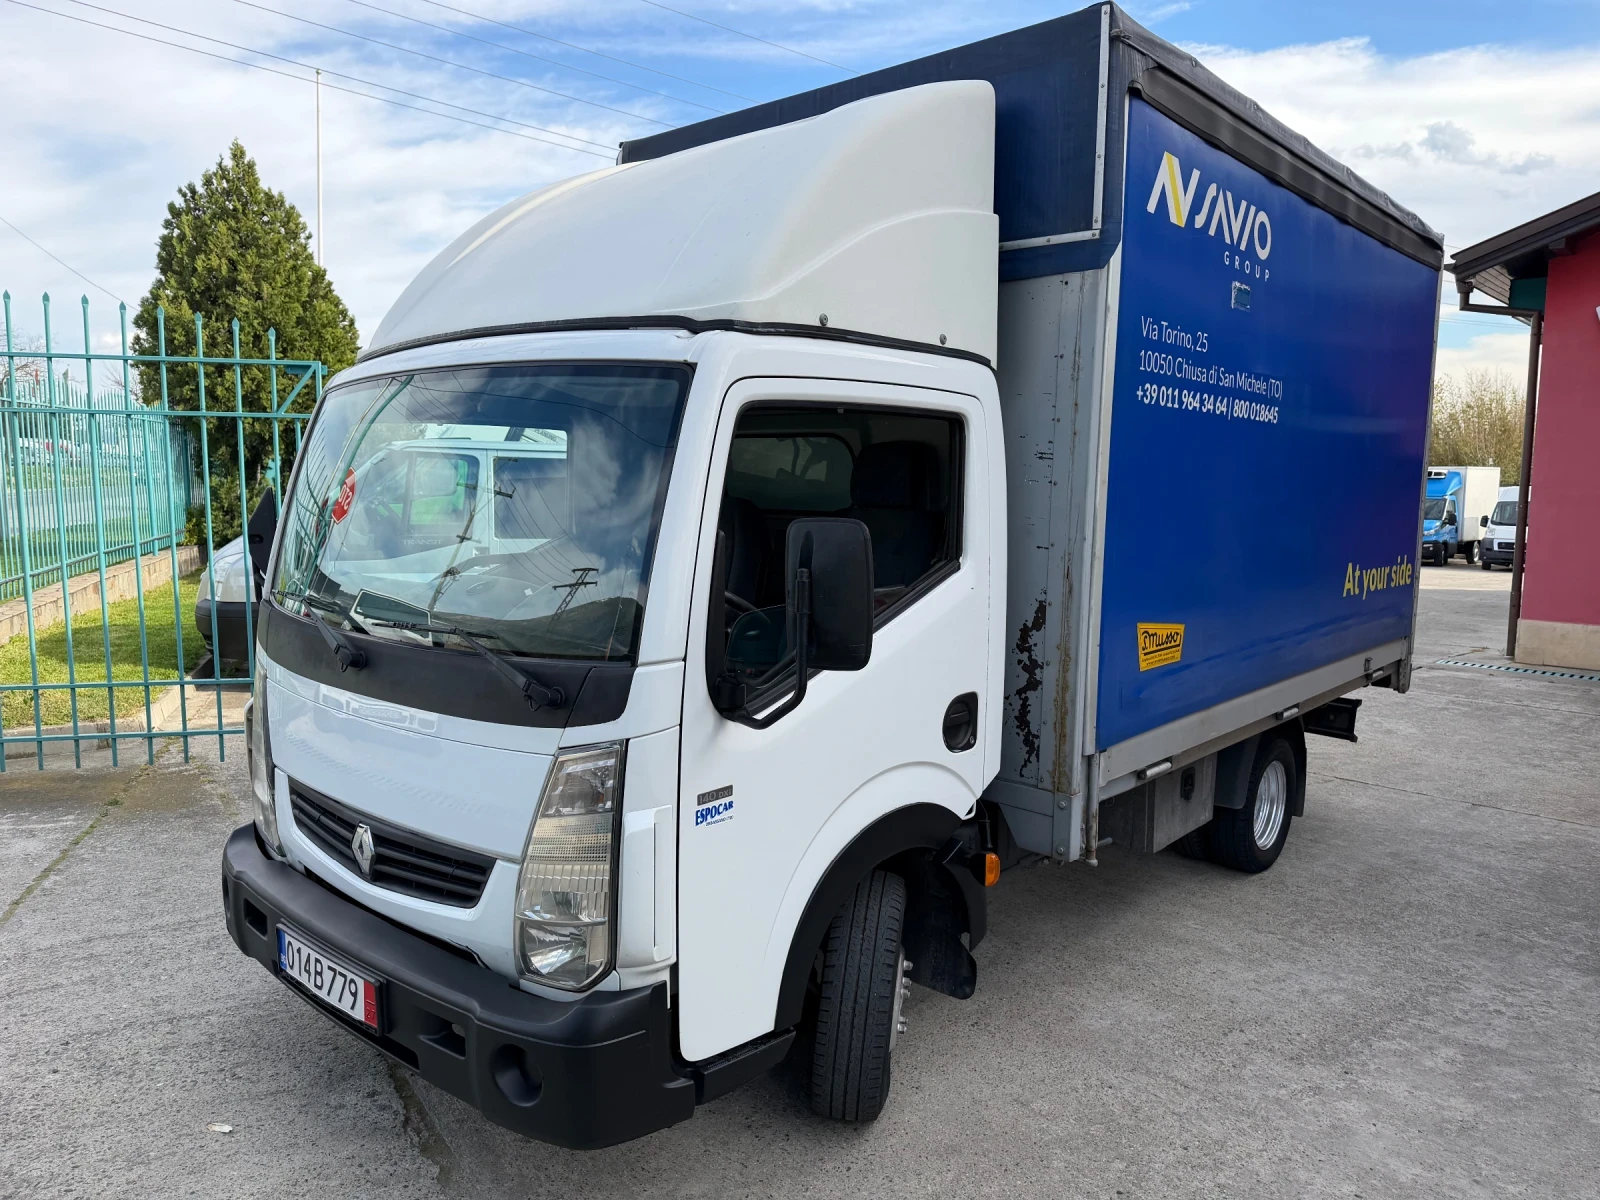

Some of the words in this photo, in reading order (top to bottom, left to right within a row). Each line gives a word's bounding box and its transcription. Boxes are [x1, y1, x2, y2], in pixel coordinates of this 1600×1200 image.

[1194, 182, 1272, 260] SAVIO
[1224, 250, 1270, 282] GROUP
[1141, 315, 1159, 340] Via
[1161, 320, 1194, 352] Torino,
[1195, 331, 1208, 352] 25
[1139, 349, 1174, 375] 10050
[1174, 357, 1207, 383] Chiusa
[1208, 365, 1218, 385] di
[1218, 367, 1235, 388] San
[1236, 371, 1267, 395] Michele
[1267, 378, 1283, 400] (TO)
[1136, 383, 1158, 404] +39
[1159, 385, 1179, 408] 011
[1181, 389, 1200, 411] 964
[1201, 393, 1214, 413] 34
[1215, 396, 1228, 416] 64
[1232, 398, 1250, 419] 800
[1250, 402, 1279, 424] 018645
[1342, 562, 1360, 597] At
[1362, 566, 1390, 600] your
[1390, 555, 1412, 588] side
[695, 800, 734, 827] ESPOCAR
[699, 791, 717, 805] 140
[286, 940, 358, 1011] 014B779
